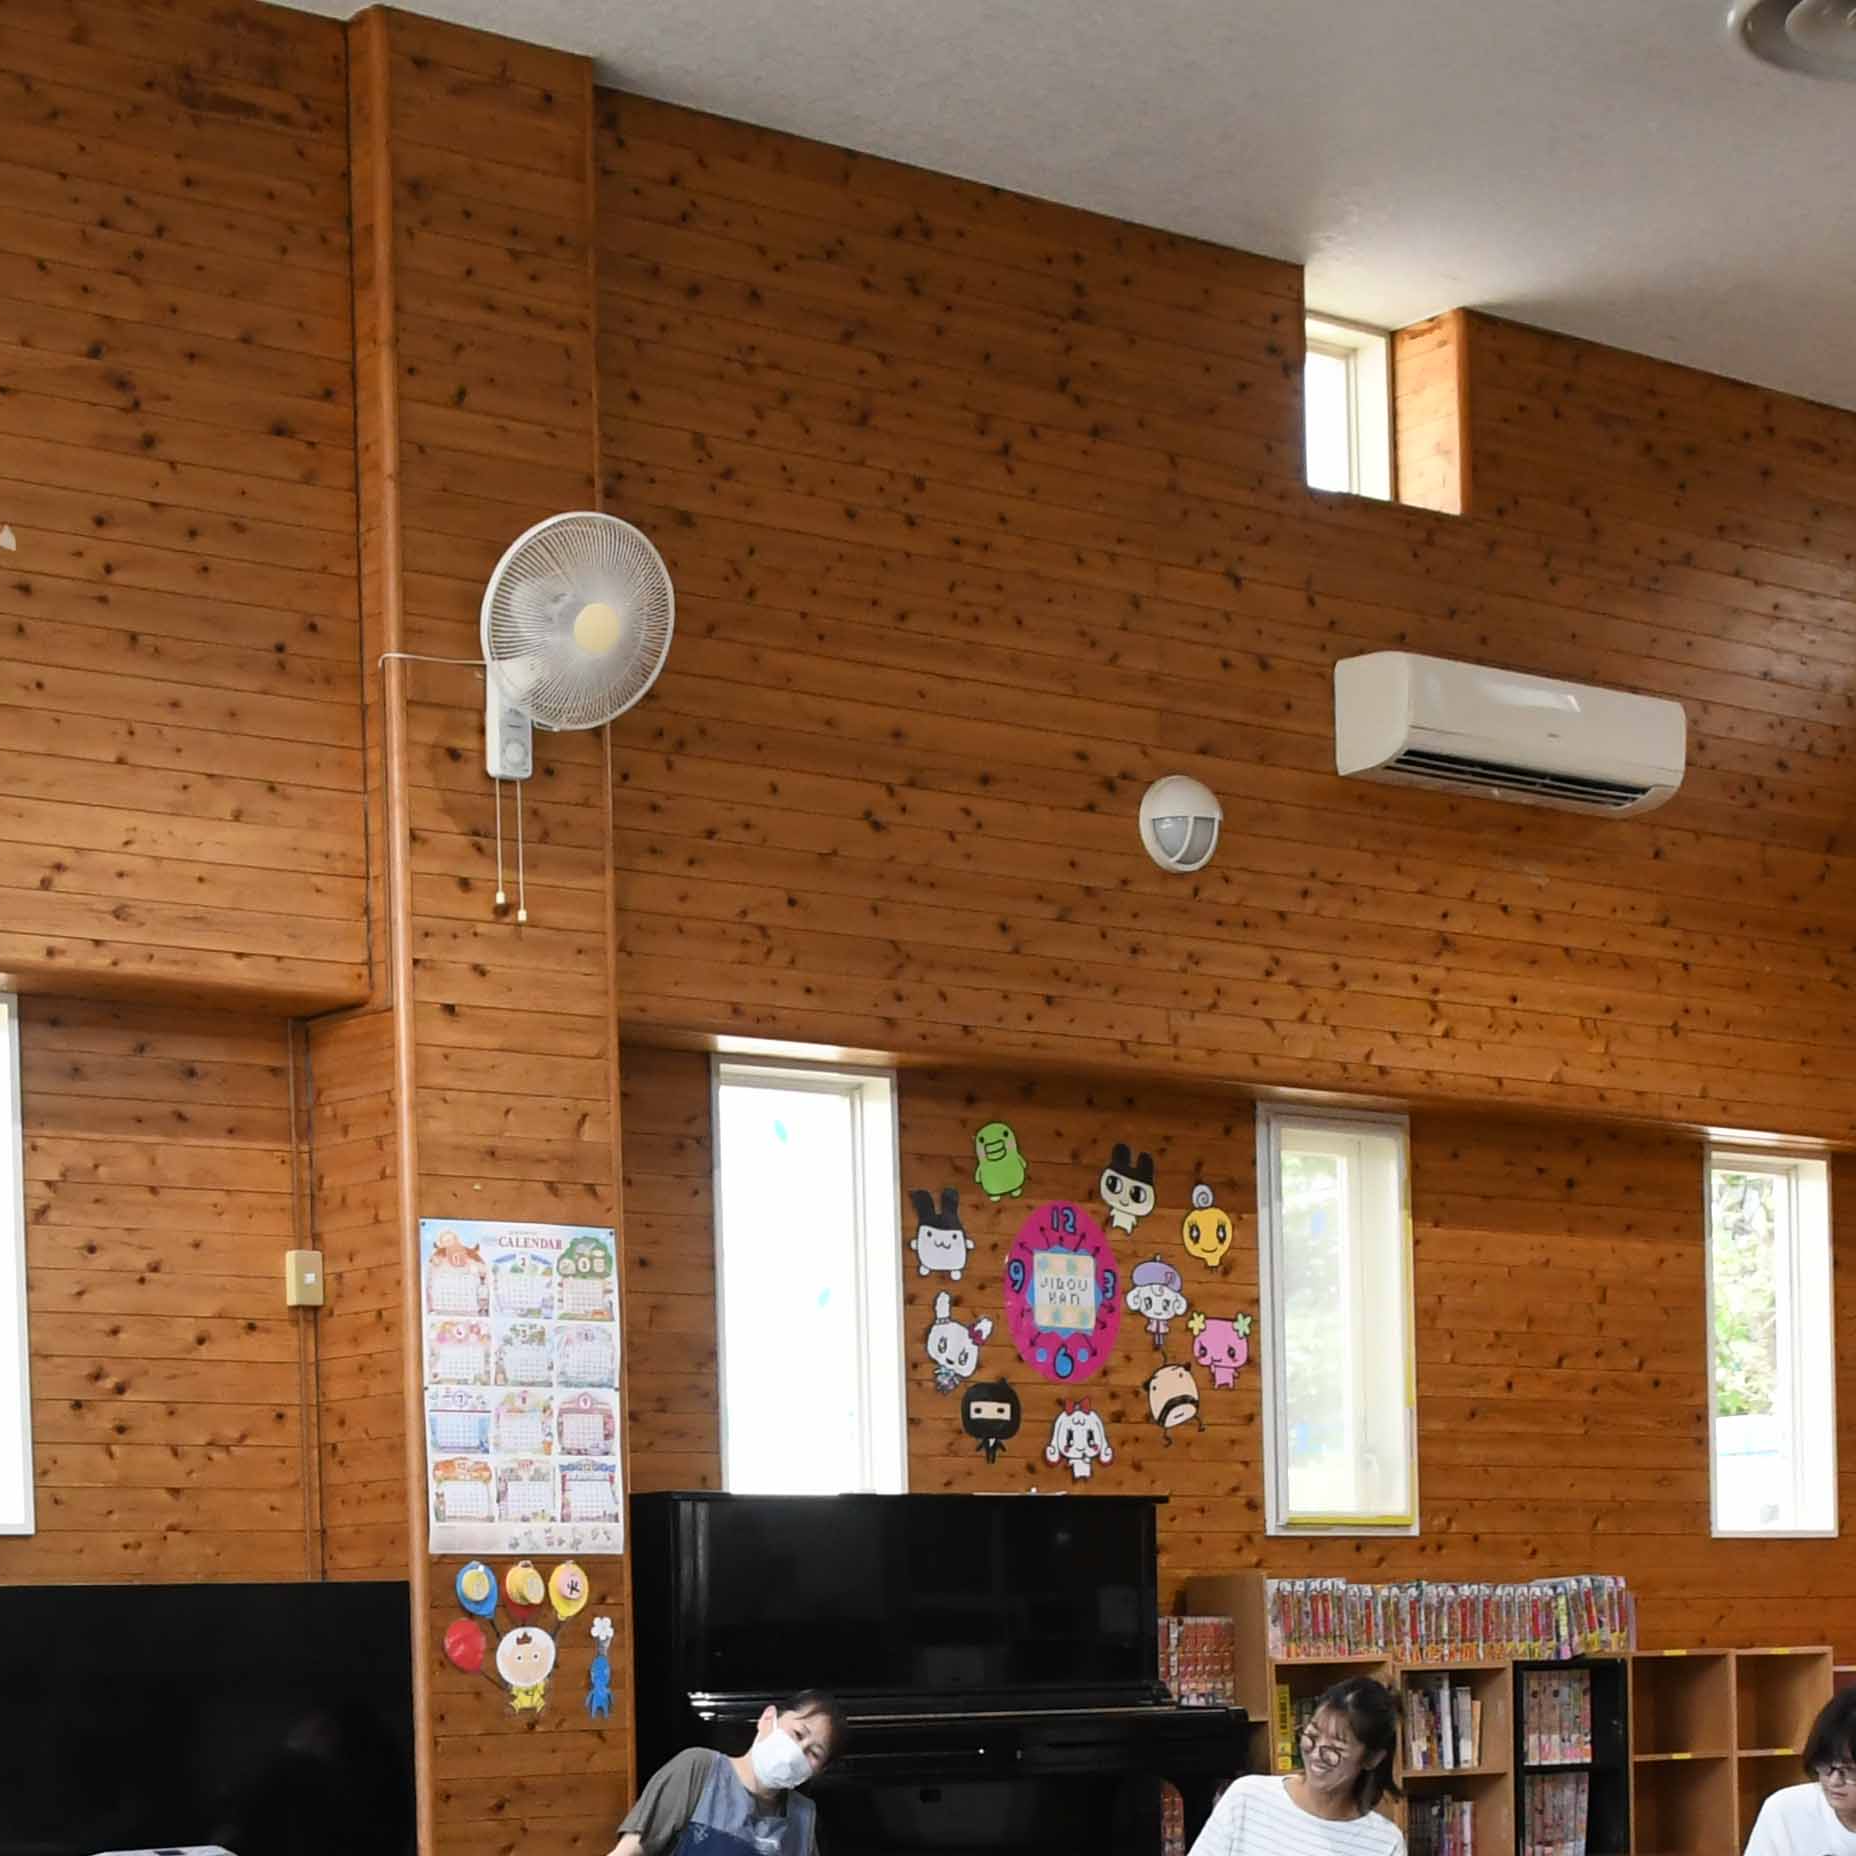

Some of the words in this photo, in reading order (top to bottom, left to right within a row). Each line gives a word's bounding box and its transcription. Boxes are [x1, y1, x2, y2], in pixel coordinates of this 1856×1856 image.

[1051, 1206, 1076, 1234] 12
[498, 1236, 562, 1250] CALENDAR
[1009, 1259, 1025, 1293] 9
[1102, 1269, 1116, 1300] 3
[1054, 1344, 1074, 1379] 6
